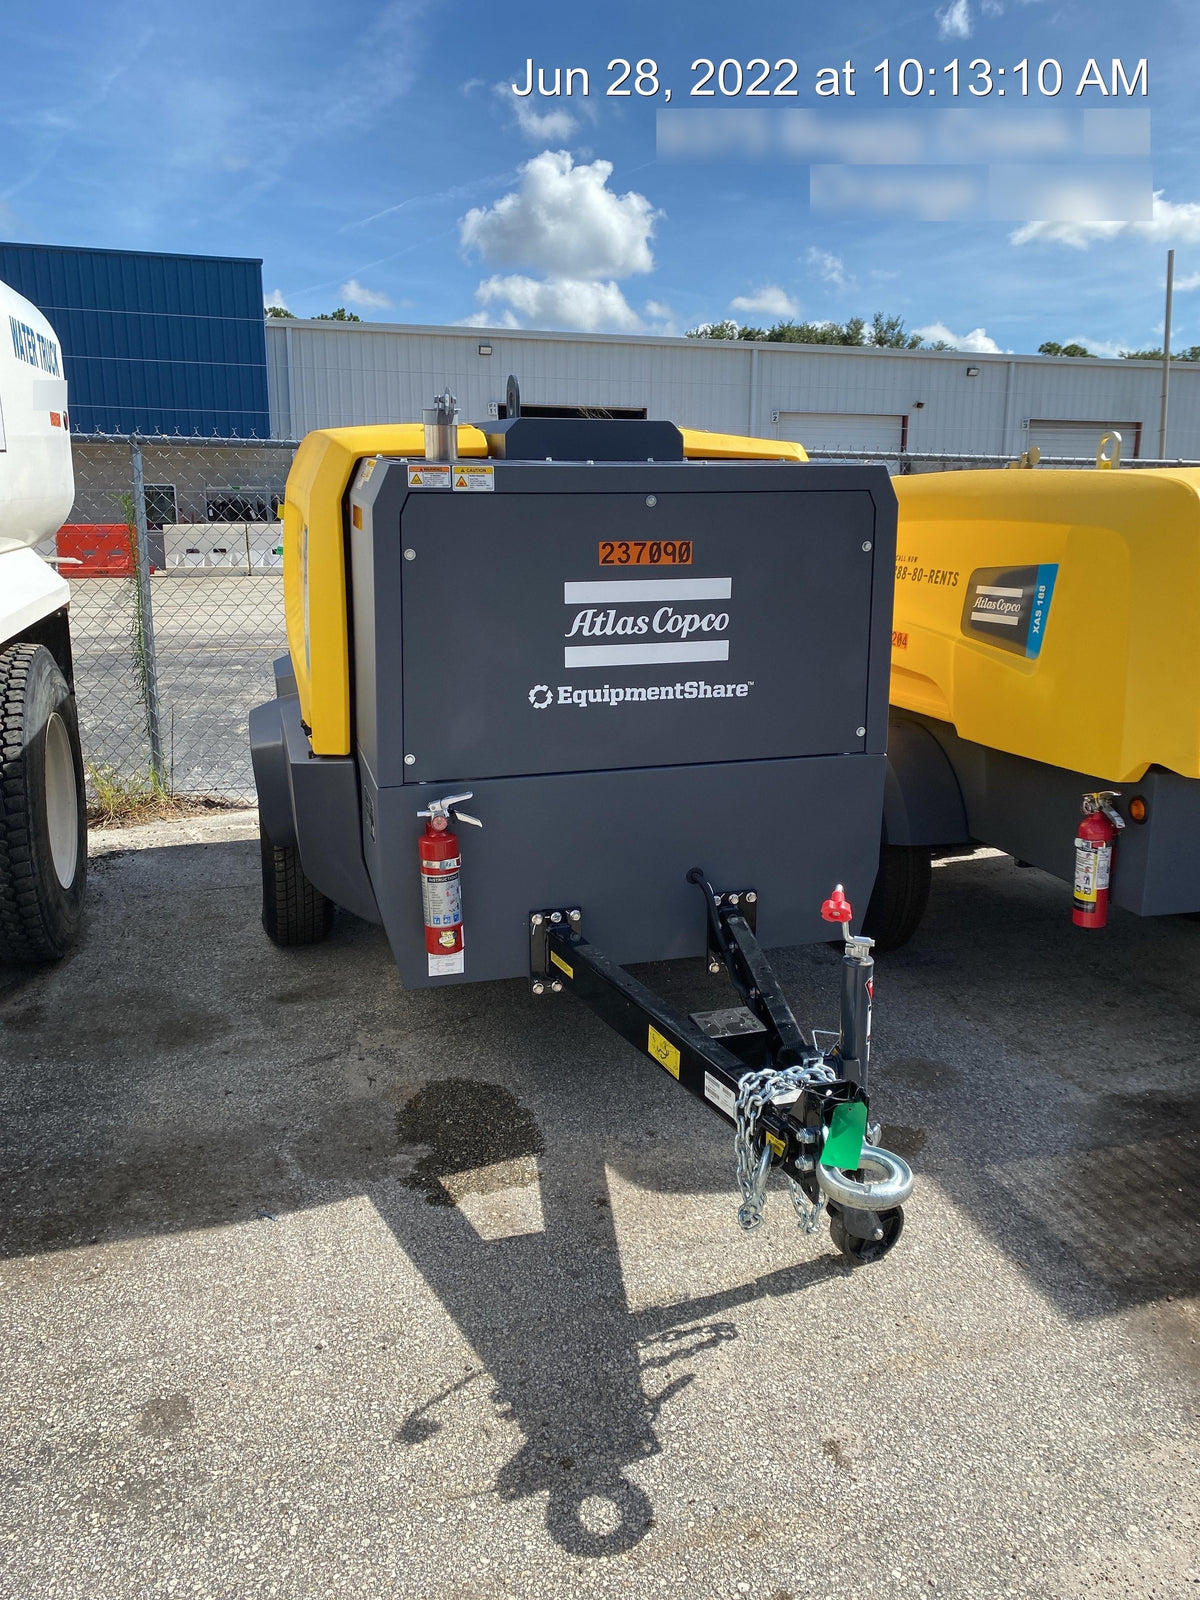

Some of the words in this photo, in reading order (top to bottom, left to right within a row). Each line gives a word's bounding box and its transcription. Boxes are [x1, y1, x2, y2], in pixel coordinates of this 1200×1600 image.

[9, 315, 39, 368] WATER
[36, 332, 60, 377] TRUCK
[601, 541, 691, 564] 237090
[895, 566, 959, 587] 88-80-RENTS
[973, 596, 996, 610] Atlas
[996, 598, 1021, 613] Copco
[1032, 610, 1042, 634] XAS
[1037, 585, 1046, 605] 188
[565, 609, 649, 638] Atlas
[652, 606, 730, 638] Copco
